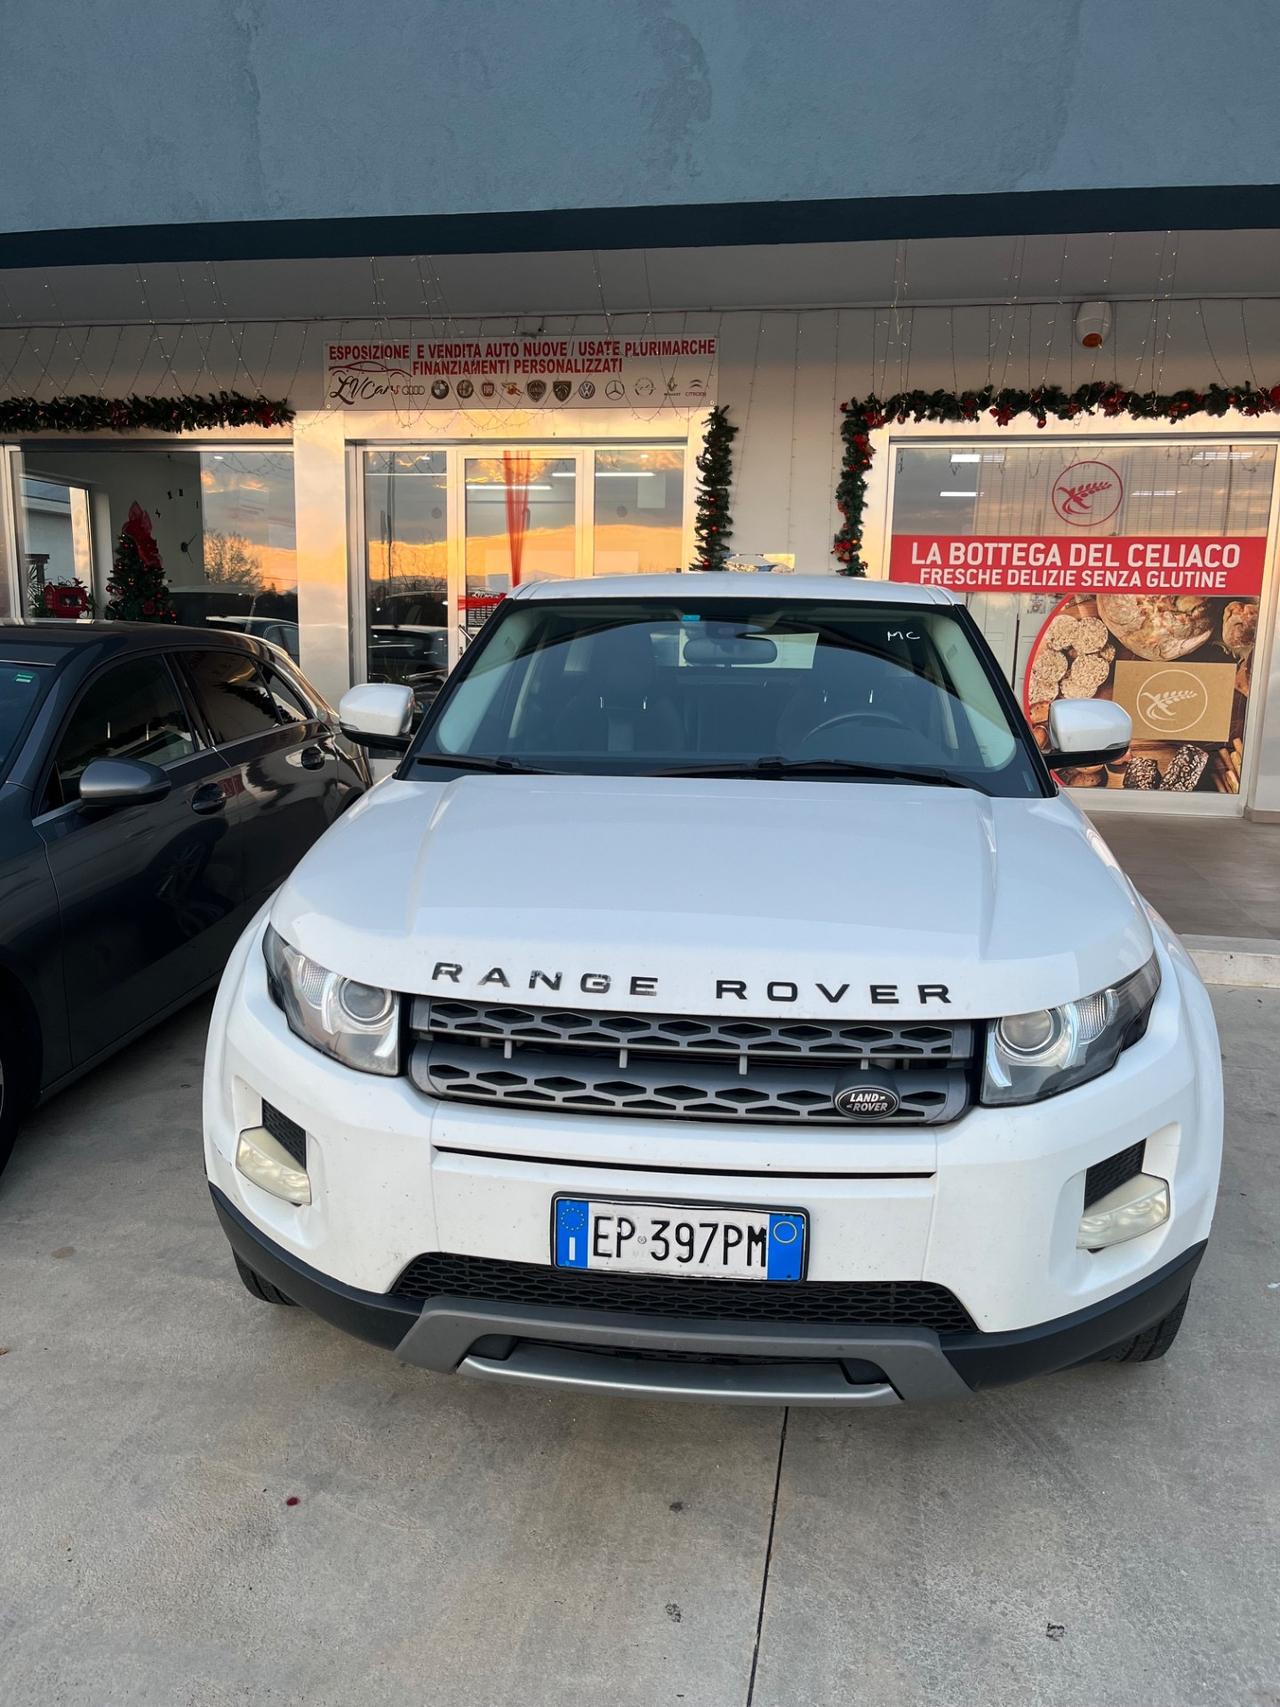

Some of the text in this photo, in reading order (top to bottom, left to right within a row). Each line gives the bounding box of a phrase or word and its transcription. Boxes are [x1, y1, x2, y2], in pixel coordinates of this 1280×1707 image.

[329, 345, 410, 360] ESPOSIZIONE
[417, 344, 425, 359] E
[428, 343, 482, 359] VENDITA
[485, 342, 520, 358] AUTO
[523, 341, 567, 357] NUOVE
[578, 341, 620, 356] USATE
[624, 339, 716, 357] PLURIMARCHE
[412, 358, 623, 376] FINANZIAMENTI PERSONALIZZATI
[911, 542, 1241, 568] LA BOTTEGA DEL CELIACO
[920, 568, 1228, 588] FRESCHE DELIZIE SENZA GLUTINE
[431, 962, 952, 1004] RANGE ROVER
[850, 1093, 879, 1103] LAND
[852, 1102, 888, 1112] ROVER
